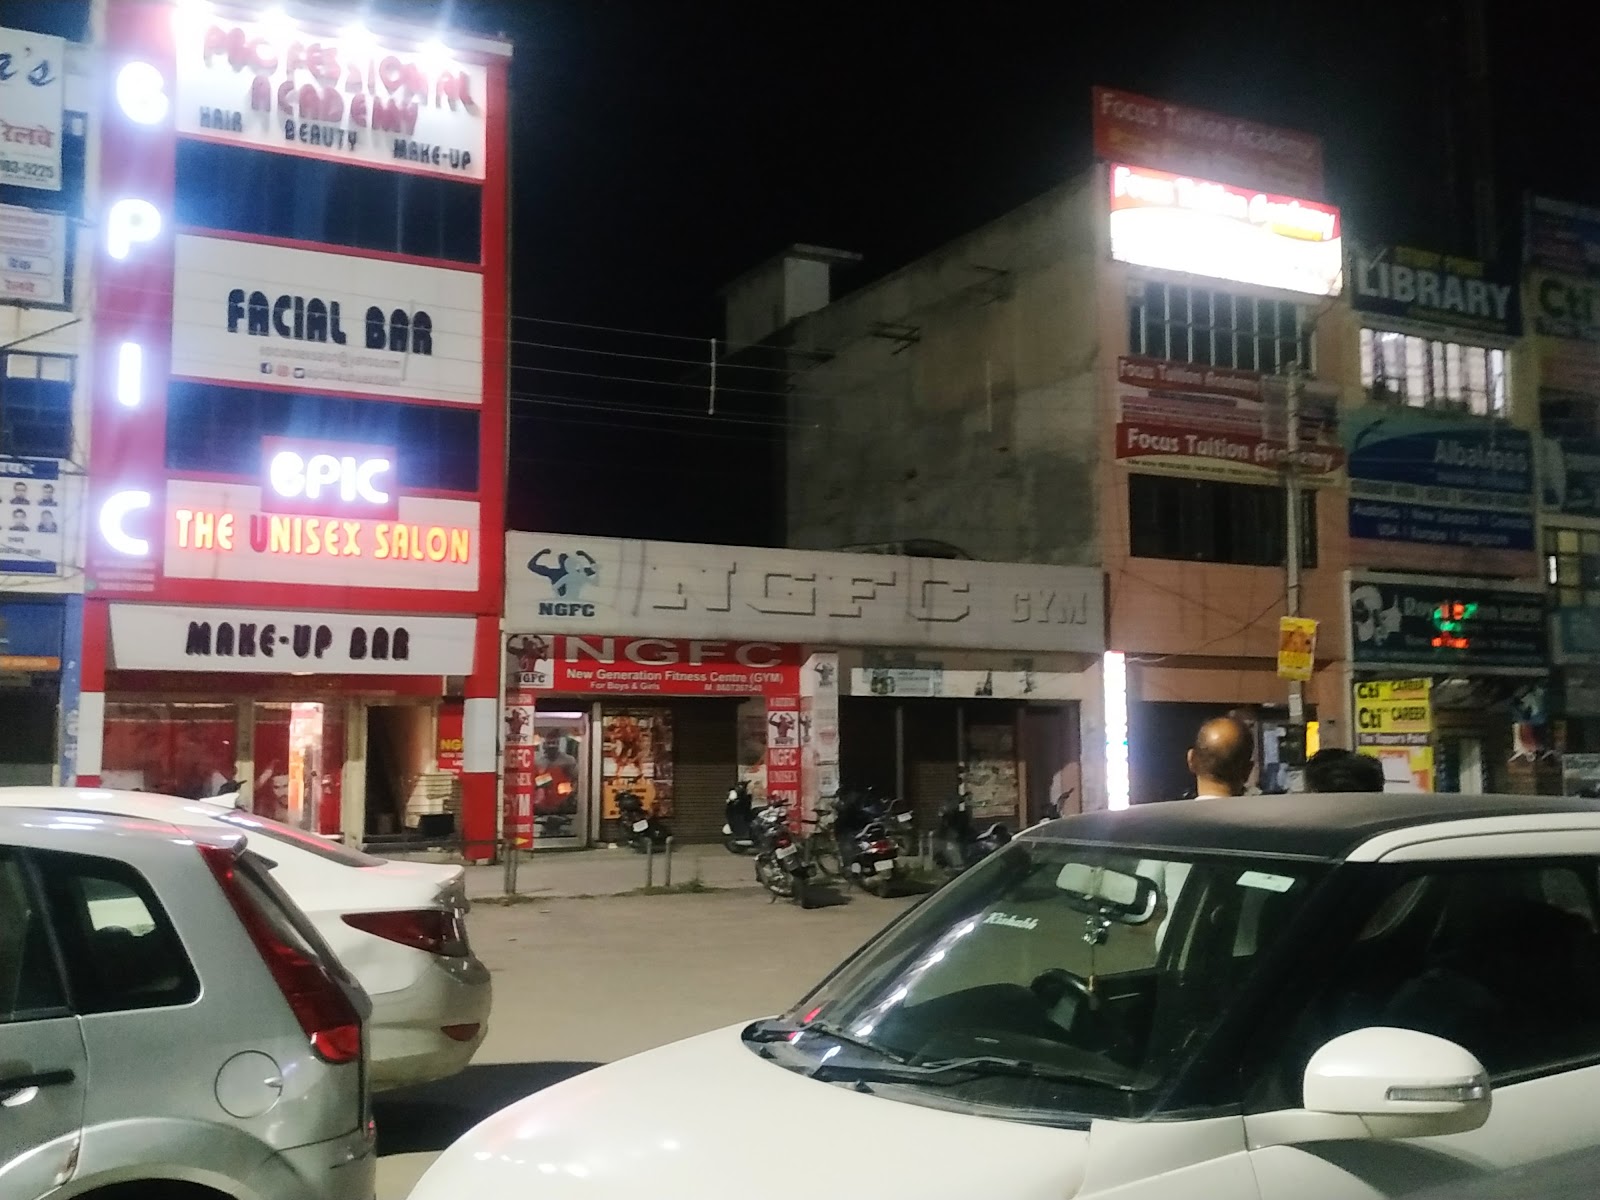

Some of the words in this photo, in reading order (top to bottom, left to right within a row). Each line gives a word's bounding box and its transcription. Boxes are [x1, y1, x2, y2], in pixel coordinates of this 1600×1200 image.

[251, 75, 418, 135] ACADEMY
[200, 105, 242, 132] HAIR
[285, 119, 357, 151] BEAUTY
[393, 138, 471, 170] MAKE-UP
[1357, 256, 1511, 320] LIBRARY
[227, 288, 347, 345] FACIAL
[365, 306, 433, 355] BAR
[1128, 427, 1179, 452] Focus
[1185, 434, 1249, 459] Tuition
[175, 509, 234, 550] THE
[250, 514, 361, 556] UNISEX
[374, 523, 469, 564] SALON
[538, 602, 595, 617] NGFC
[1011, 589, 1088, 625] GYM
[186, 621, 332, 658] MAKE-UP
[349, 626, 409, 660] BAR
[565, 636, 783, 668] NGFC
[566, 668, 593, 680] New
[597, 668, 662, 681] Generation
[665, 670, 706, 682] Fitness
[710, 671, 747, 683] Centre
[749, 672, 784, 686] (GYM)
[590, 681, 606, 689] For
[607, 682, 629, 691] Boys
[640, 682, 660, 690] Girls
[1391, 707, 1426, 721] CAREER
[770, 749, 797, 766] NGFC
[770, 771, 797, 782] UNISEX
